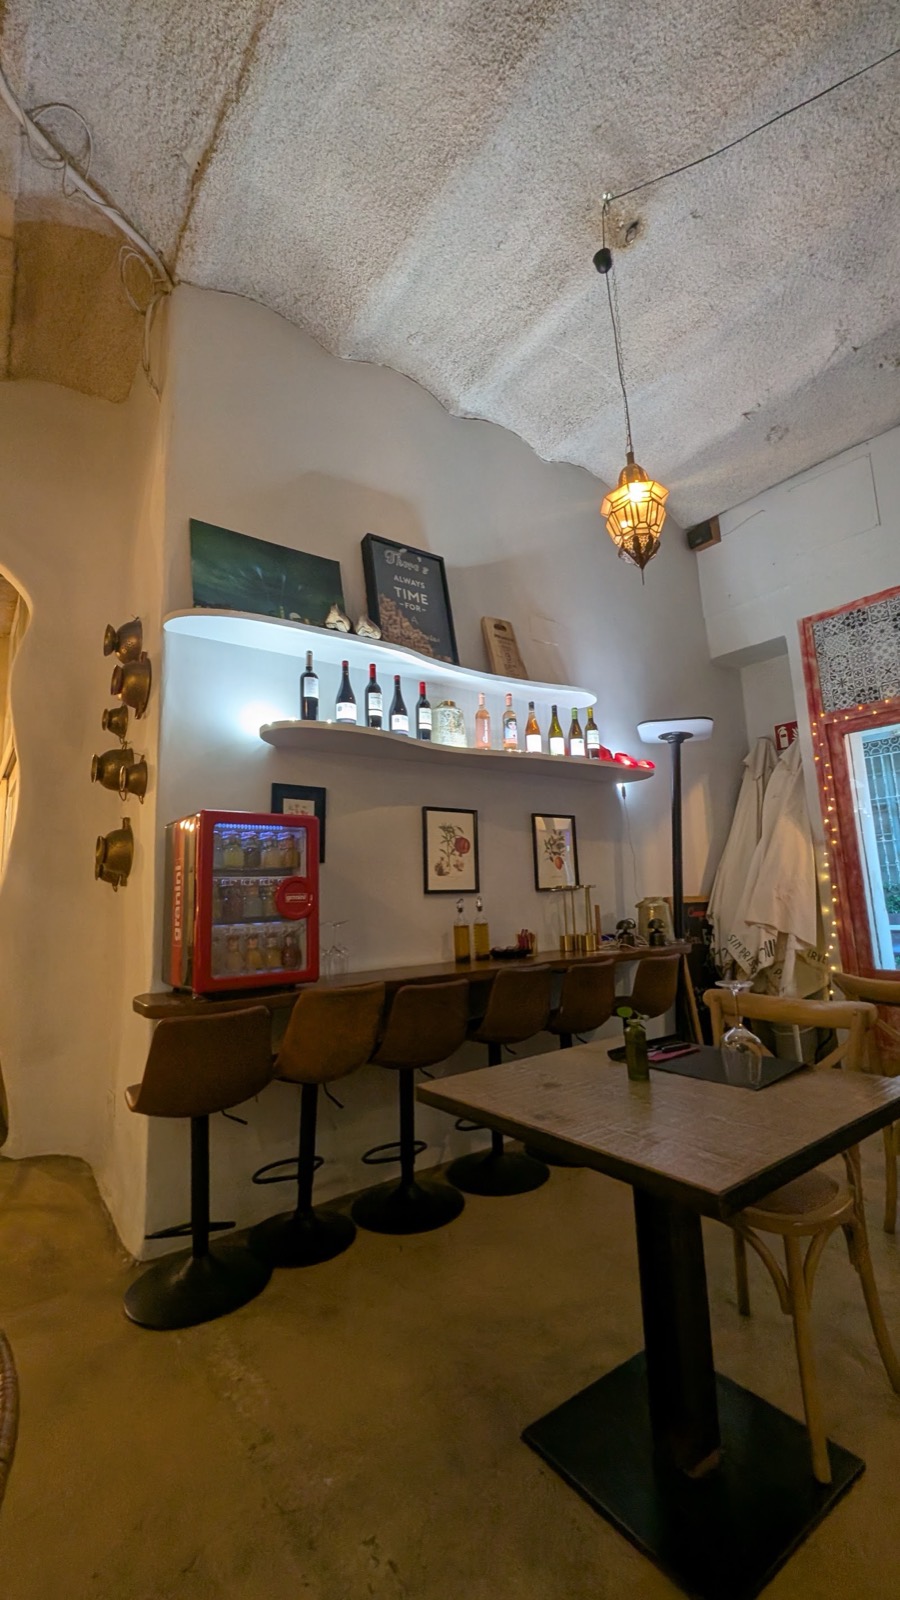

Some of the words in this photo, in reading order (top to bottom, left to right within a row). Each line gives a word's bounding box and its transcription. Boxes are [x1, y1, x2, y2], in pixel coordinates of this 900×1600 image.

[393, 575, 426, 589] ALWAYS
[394, 586, 429, 605] TIME
[174, 865, 182, 941] granini
